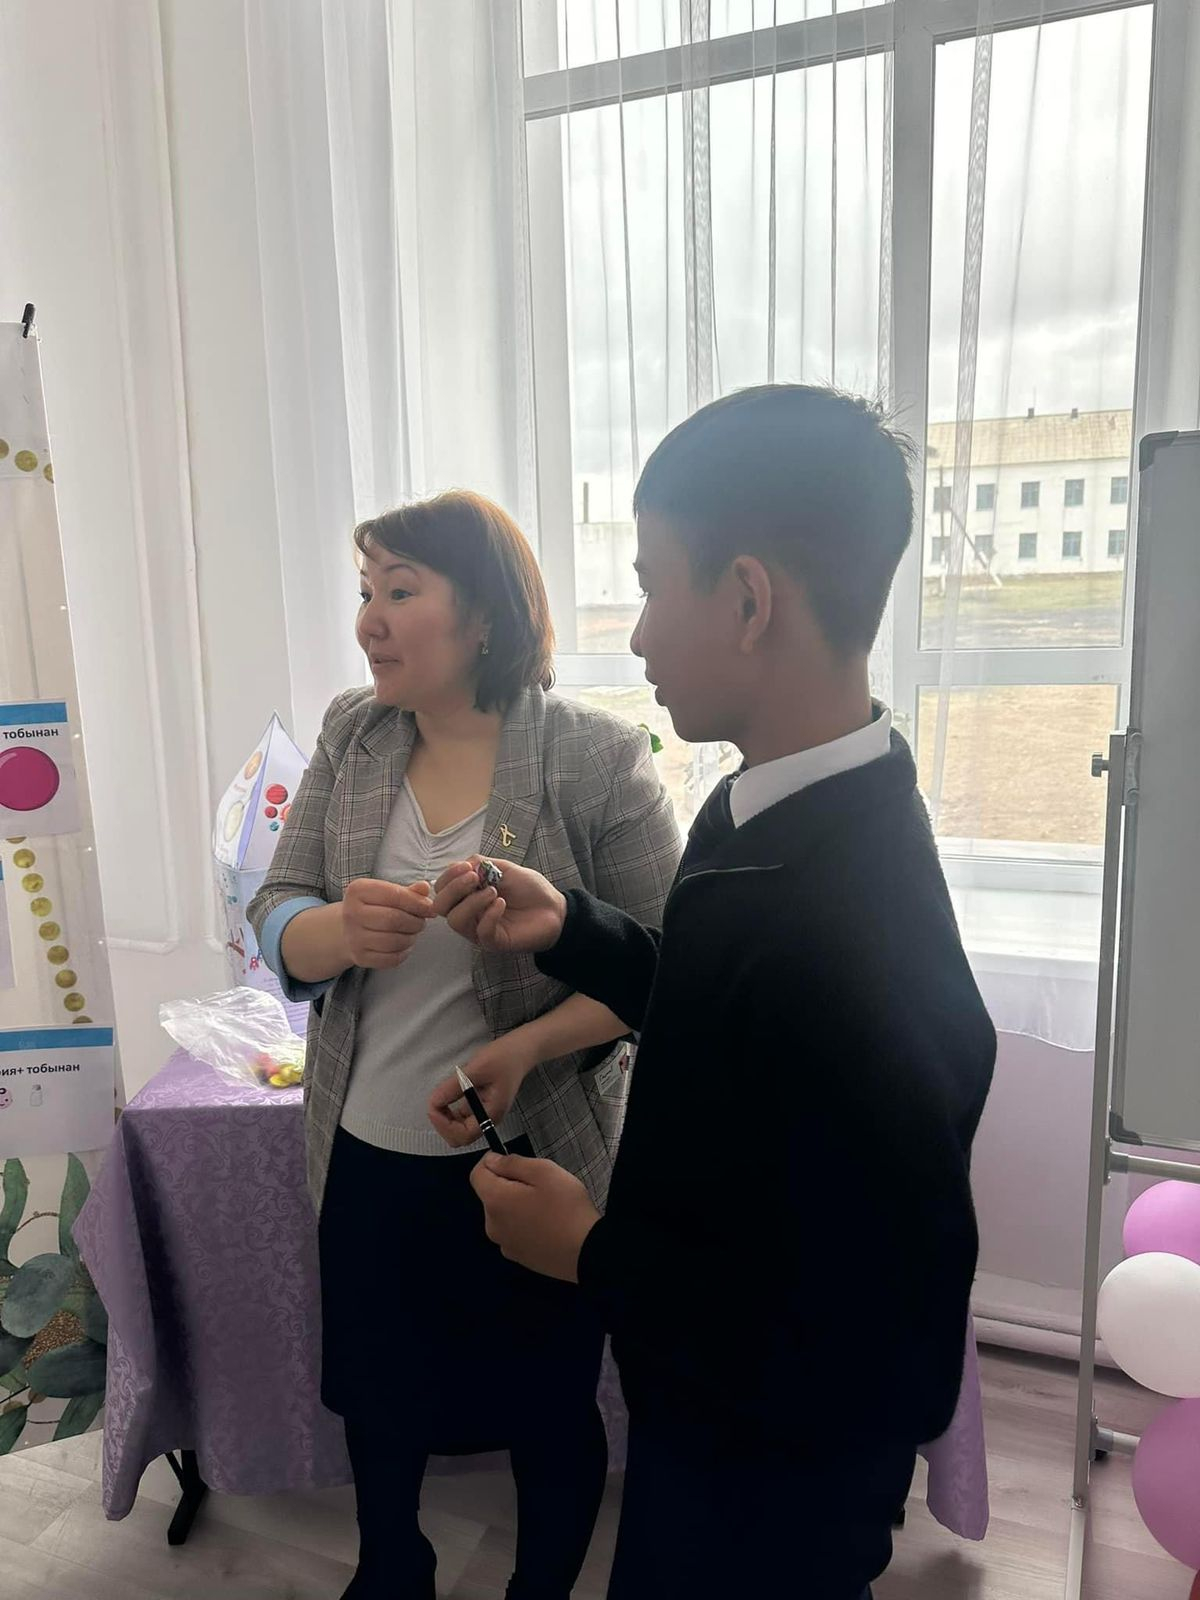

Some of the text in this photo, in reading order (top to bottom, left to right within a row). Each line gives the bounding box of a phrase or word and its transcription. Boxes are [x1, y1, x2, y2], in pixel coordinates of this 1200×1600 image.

[3, 728, 59, 739] тобынан
[0, 1063, 80, 1076] ия+ тобынан
